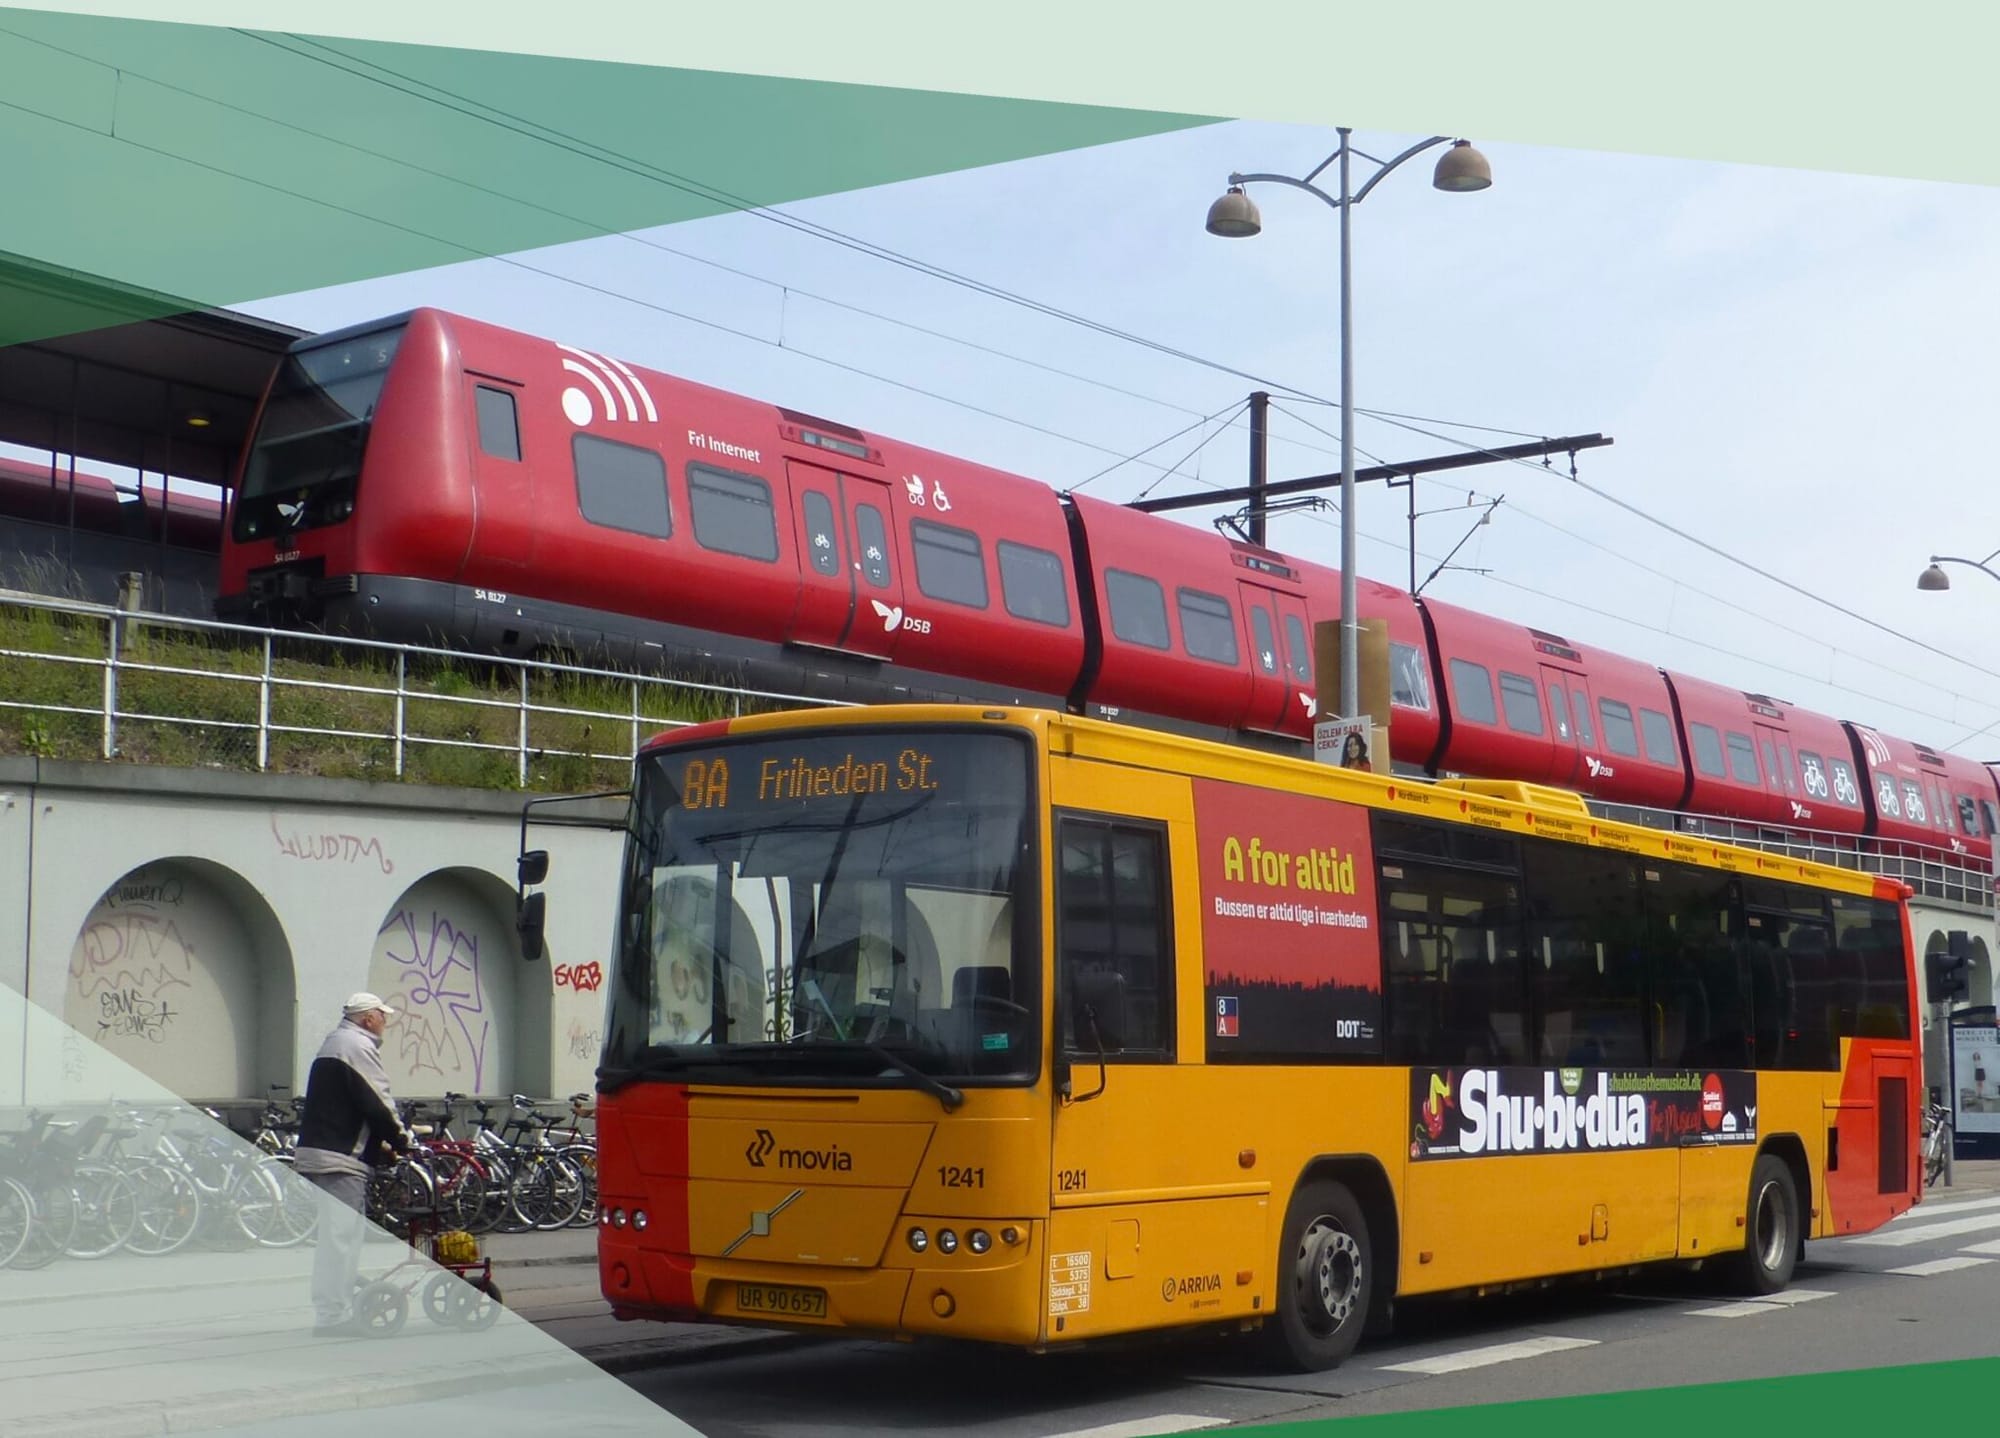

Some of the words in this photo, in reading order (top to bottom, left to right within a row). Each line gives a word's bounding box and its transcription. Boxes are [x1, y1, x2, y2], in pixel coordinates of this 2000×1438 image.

[688, 430, 705, 448] Fri
[709, 435, 760, 463] Internet
[474, 589, 486, 600] SA
[904, 618, 931, 634] DSB
[683, 758, 729, 809] 8A
[759, 754, 888, 799] Friheden
[897, 749, 938, 791] St.
[1223, 836, 1244, 882] A
[1248, 838, 1290, 887] for
[1296, 848, 1355, 895] altid
[1215, 897, 1255, 918] Bussen
[1257, 904, 1268, 919] er
[1270, 903, 1293, 922] altid
[1295, 904, 1313, 926] lige
[1320, 910, 1368, 929] nærheden
[1218, 999, 1226, 1016] 8
[1217, 1017, 1227, 1034] A
[1336, 1020, 1360, 1038] DOT
[779, 1144, 852, 1171] movia
[938, 1166, 984, 1189] 1241
[1057, 1169, 1087, 1191] 1241
[1066, 1254, 1088, 1267] 16500
[1070, 1270, 1088, 1281] 5375
[1178, 1273, 1221, 1295] ARRIVA
[741, 1288, 762, 1307] UR
